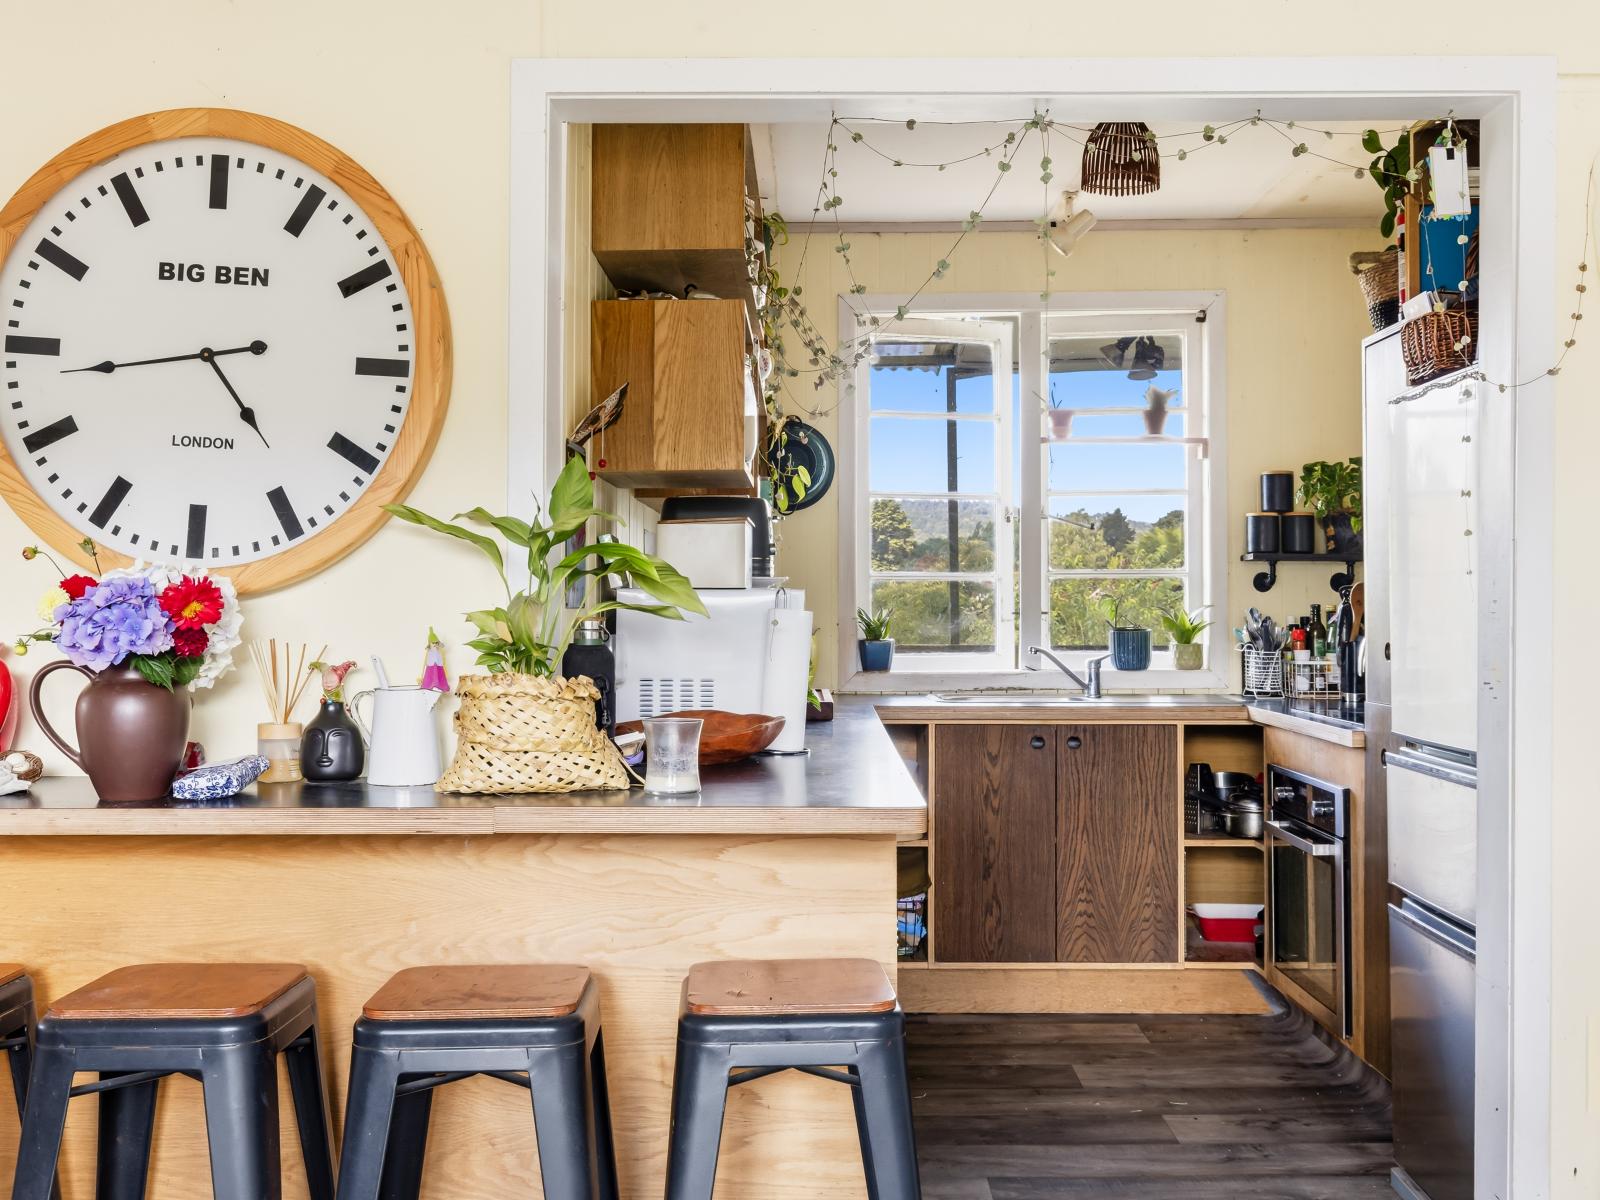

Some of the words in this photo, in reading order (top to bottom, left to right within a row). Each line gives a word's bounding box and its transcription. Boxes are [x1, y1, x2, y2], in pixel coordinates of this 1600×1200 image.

[158, 262, 205, 283] BIG
[215, 266, 269, 287] BEN
[171, 434, 234, 450] LONDON
